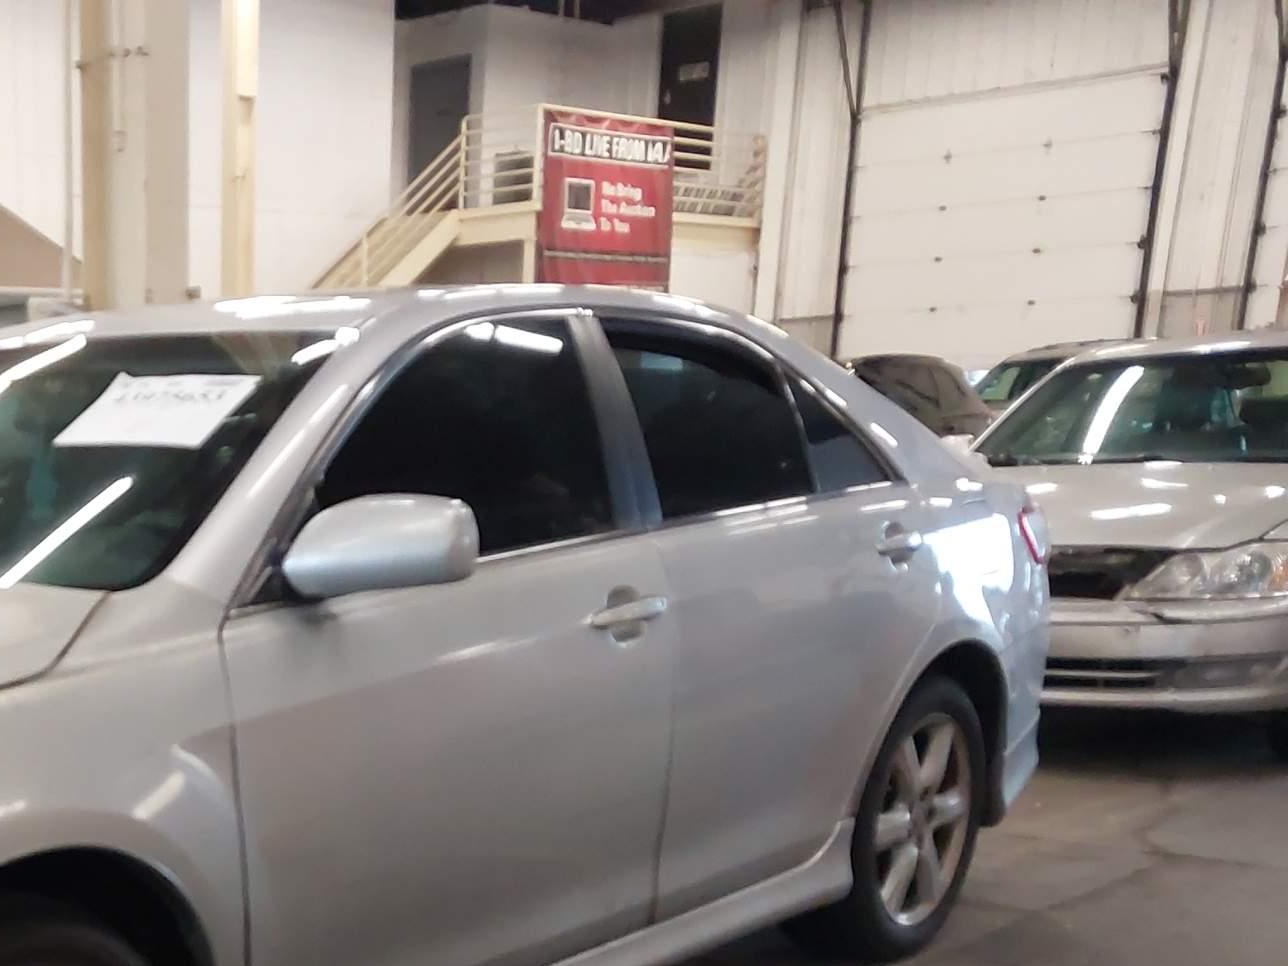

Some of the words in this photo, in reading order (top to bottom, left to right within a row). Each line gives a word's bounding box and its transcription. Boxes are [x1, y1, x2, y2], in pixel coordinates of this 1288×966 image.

[584, 132, 610, 158] LIVE
[612, 136, 646, 161] FROM
[601, 198, 617, 214] The
